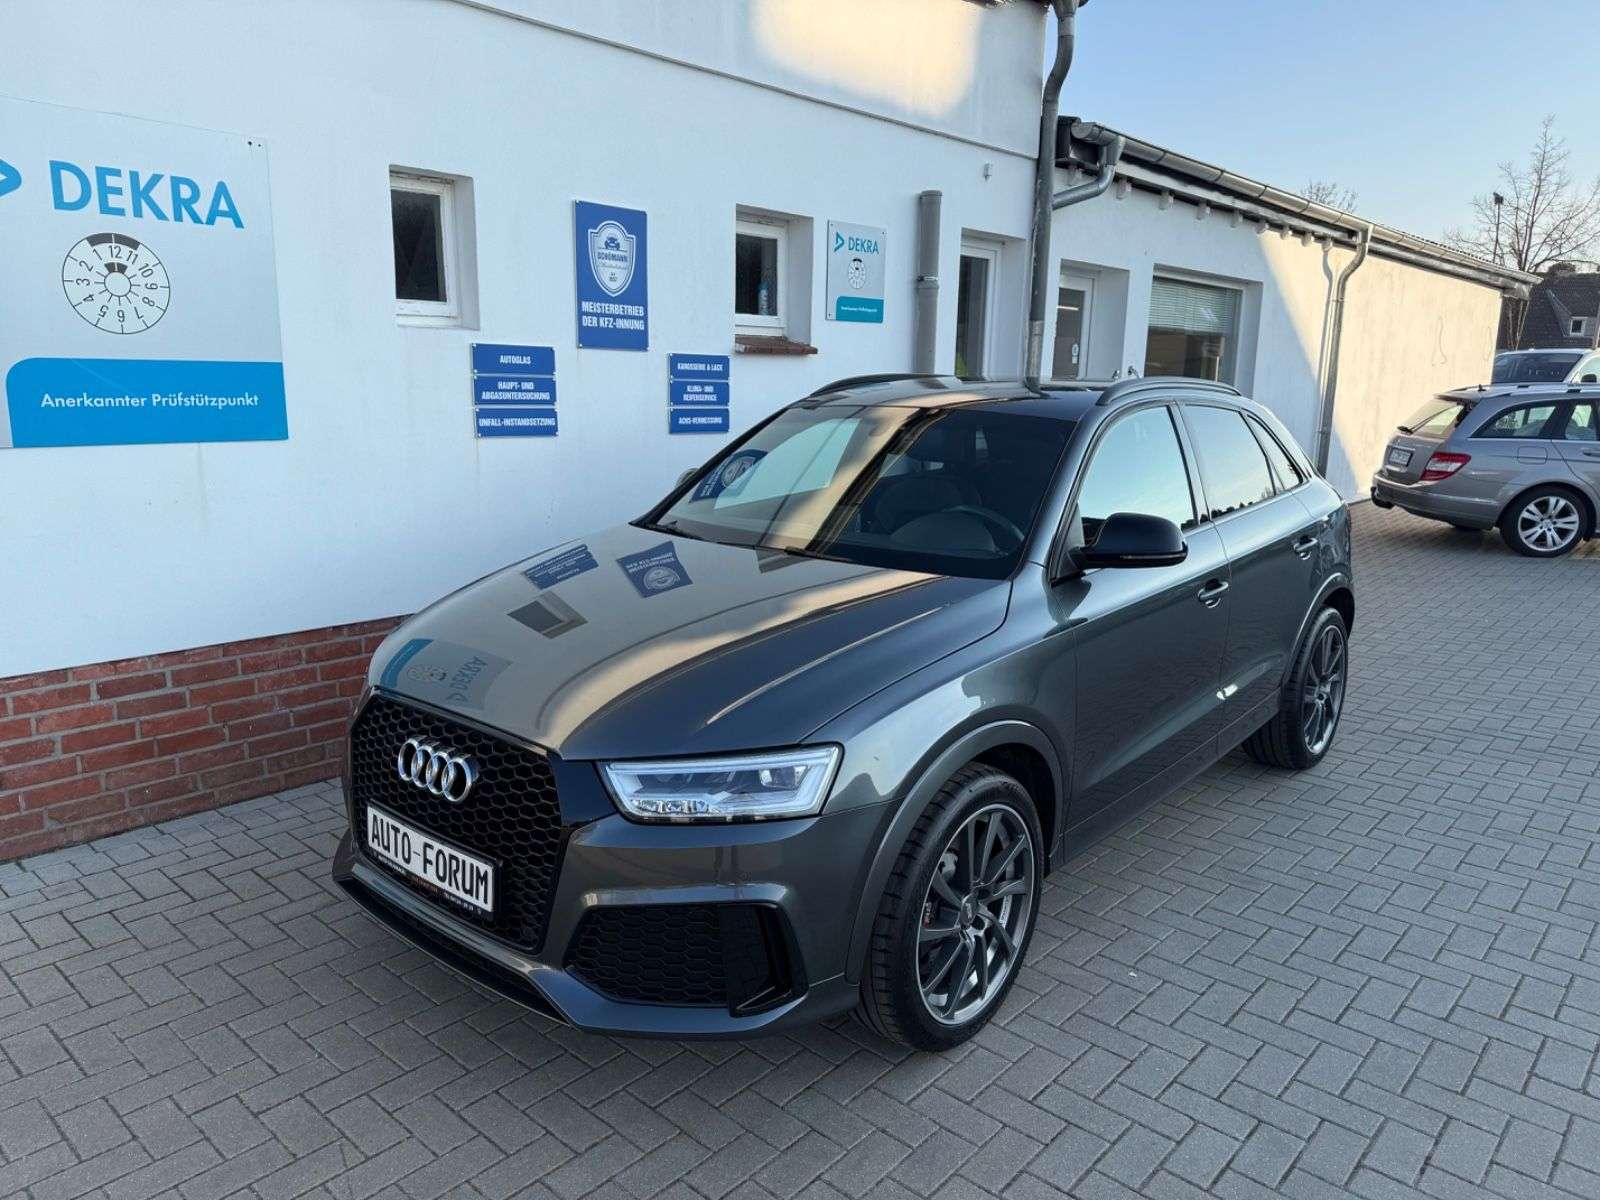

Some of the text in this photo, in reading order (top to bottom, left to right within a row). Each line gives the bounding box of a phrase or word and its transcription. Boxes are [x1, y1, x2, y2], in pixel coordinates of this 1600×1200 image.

[49, 160, 245, 229] DEKRA
[108, 245, 123, 259] 12
[848, 236, 879, 255] DEKRA
[92, 248, 103, 261] 1
[126, 250, 139, 265] 11
[79, 260, 94, 272] 2
[138, 263, 154, 278] 10
[75, 277, 91, 286] 3
[83, 293, 95, 303] 4
[142, 296, 155, 306] 8
[99, 305, 109, 318] 5
[134, 306, 144, 319] 7
[582, 300, 644, 316] MEISTERBETRIEB
[582, 316, 645, 331] DER KFZ-INNUNG
[500, 355, 531, 365] AUTOGLAS
[498, 381, 535, 390] HAUPT- UND
[41, 391, 259, 410] Anerkannter Prüfstützpunkt
[481, 391, 551, 400] ABGASUNTERSUCHUNG
[371, 814, 488, 905] AUTO-FORUM
